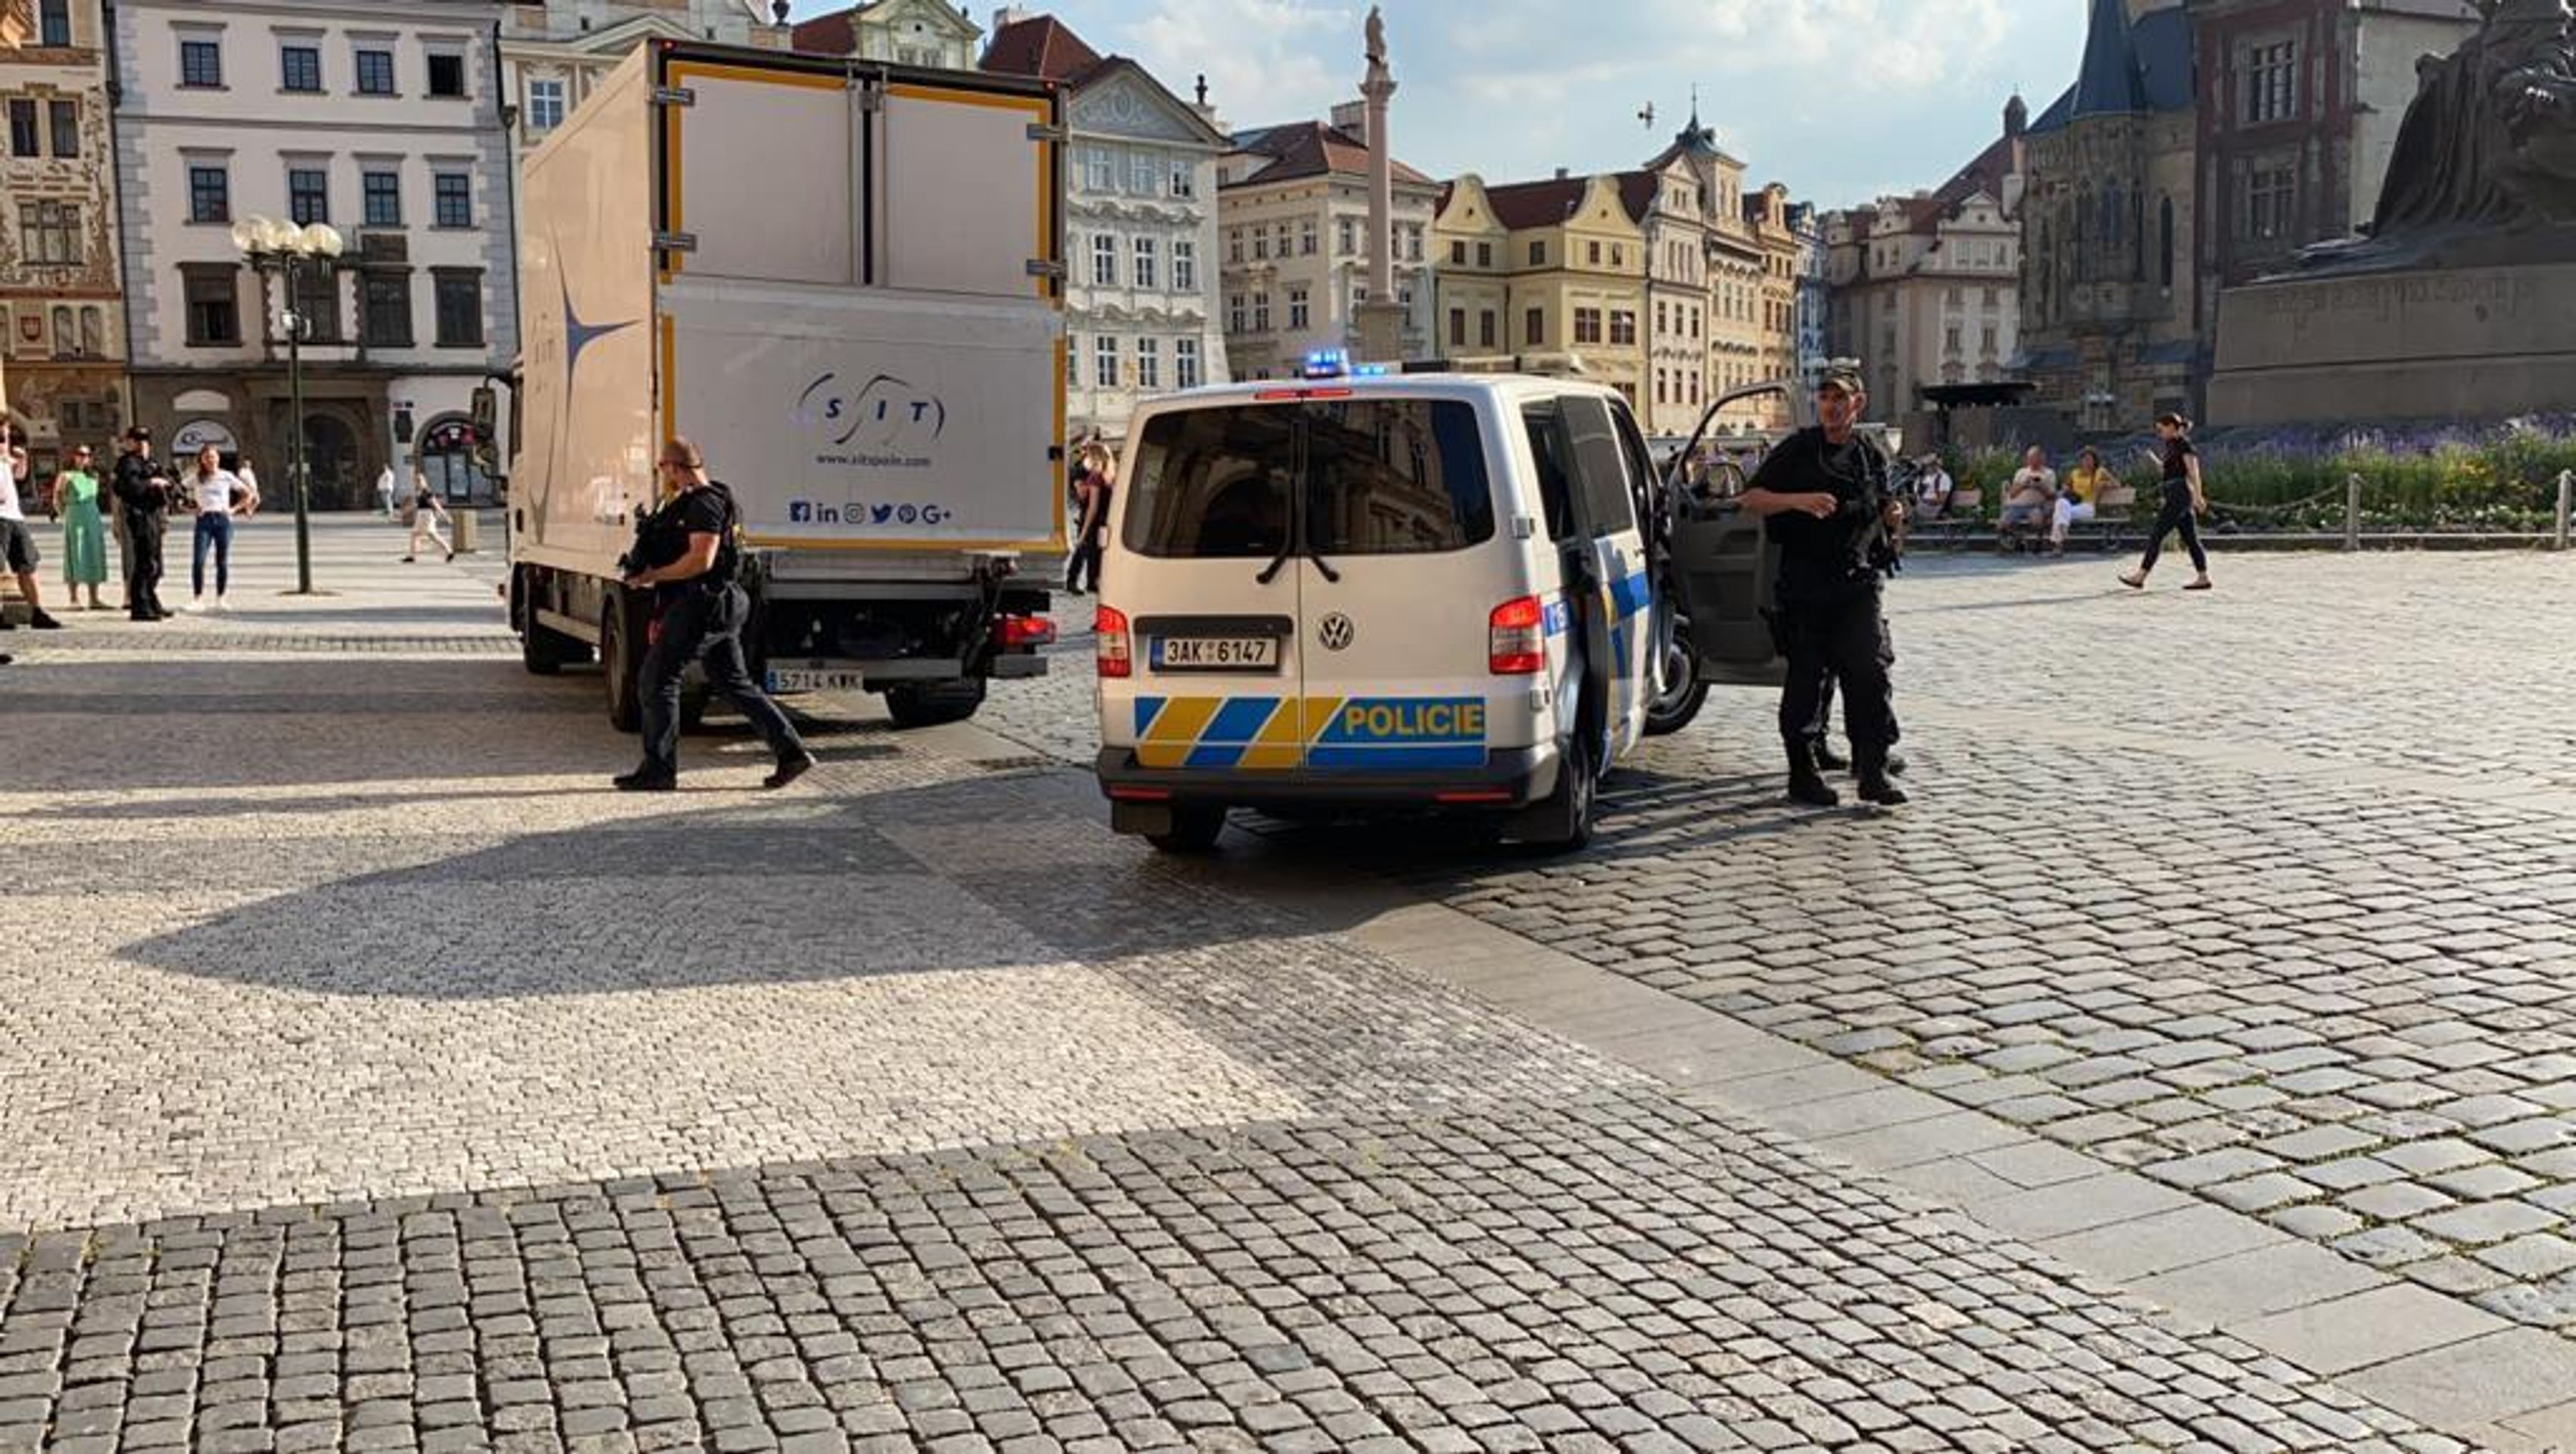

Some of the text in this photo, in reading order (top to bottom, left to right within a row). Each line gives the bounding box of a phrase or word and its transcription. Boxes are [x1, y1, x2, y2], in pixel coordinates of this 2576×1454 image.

[817, 503, 838, 522] in
[1168, 641, 1267, 663] 3AK 6147
[1346, 704, 1484, 736] POLICIE
